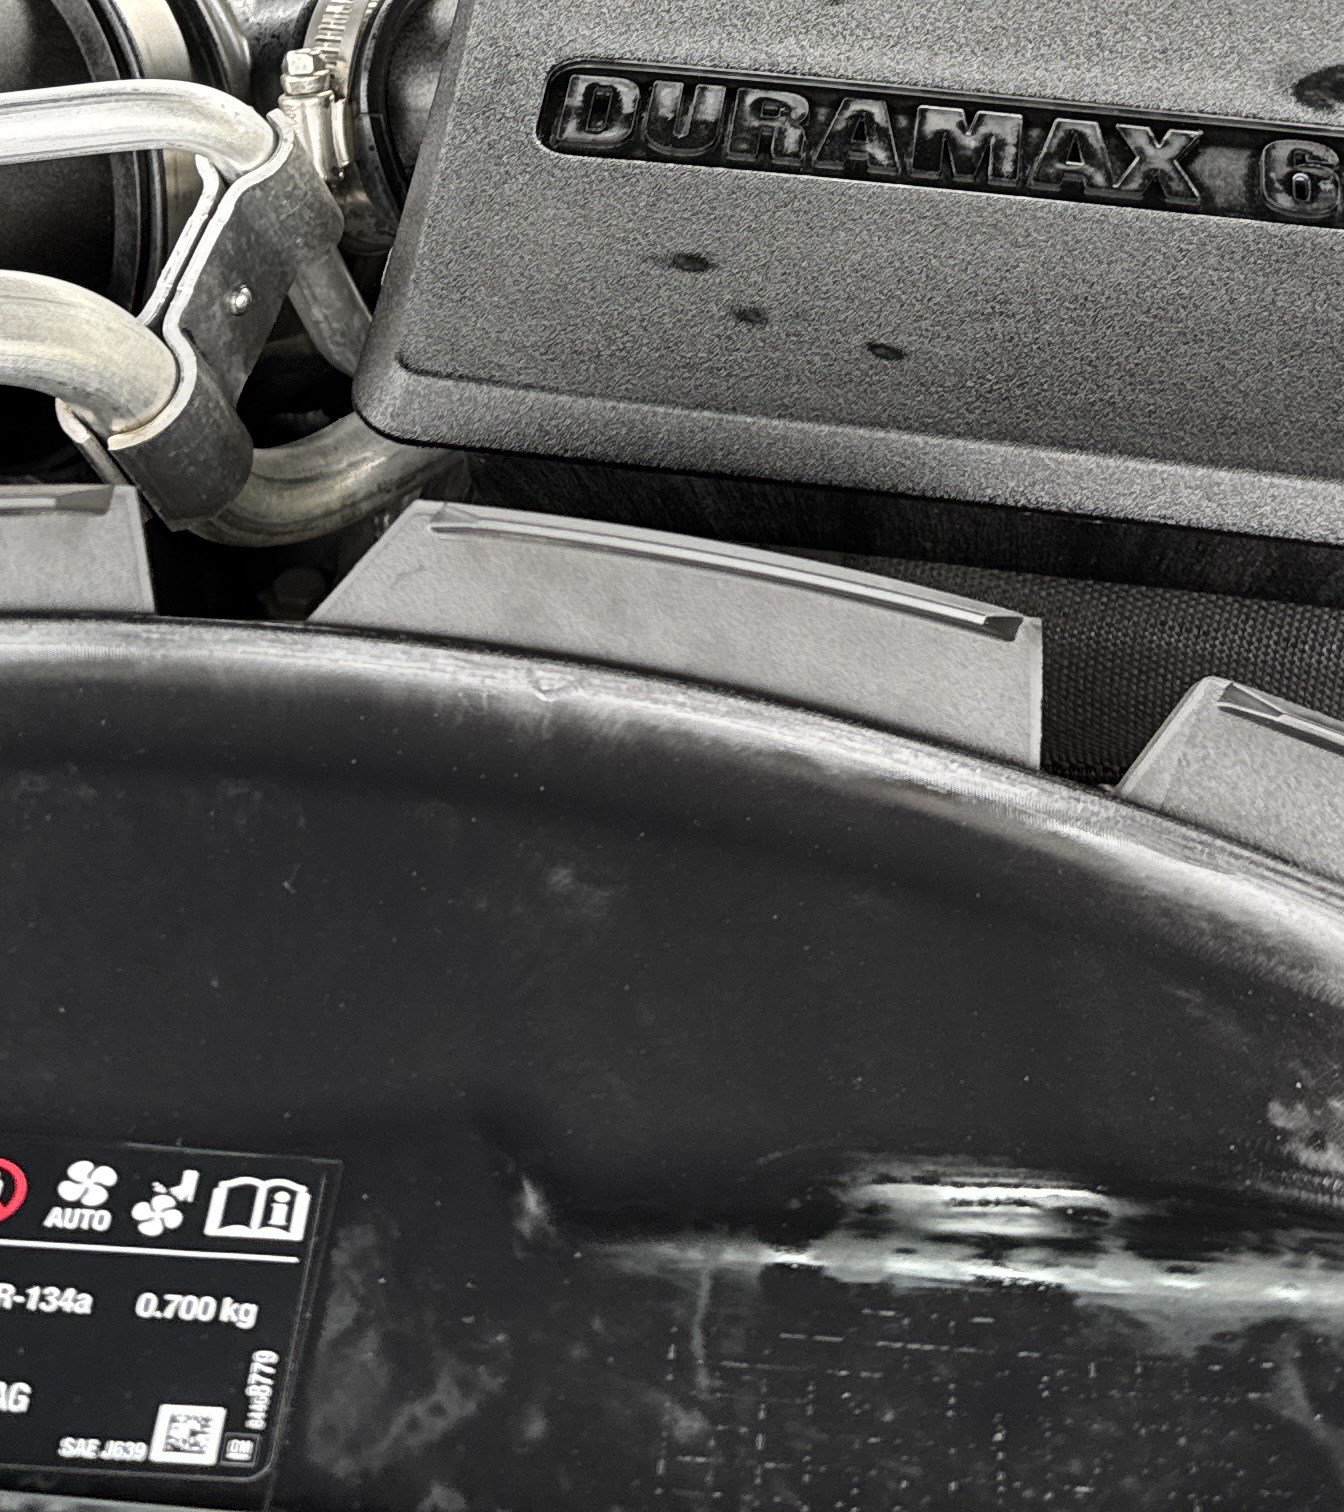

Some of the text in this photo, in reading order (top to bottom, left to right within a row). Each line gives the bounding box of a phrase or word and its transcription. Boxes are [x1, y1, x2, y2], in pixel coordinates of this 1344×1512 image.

[555, 73, 1204, 202] DURAMAX
[43, 1206, 113, 1232] AUTO
[135, 1291, 259, 1330] 0.700 kg
[57, 1436, 148, 1462] SAE J639
